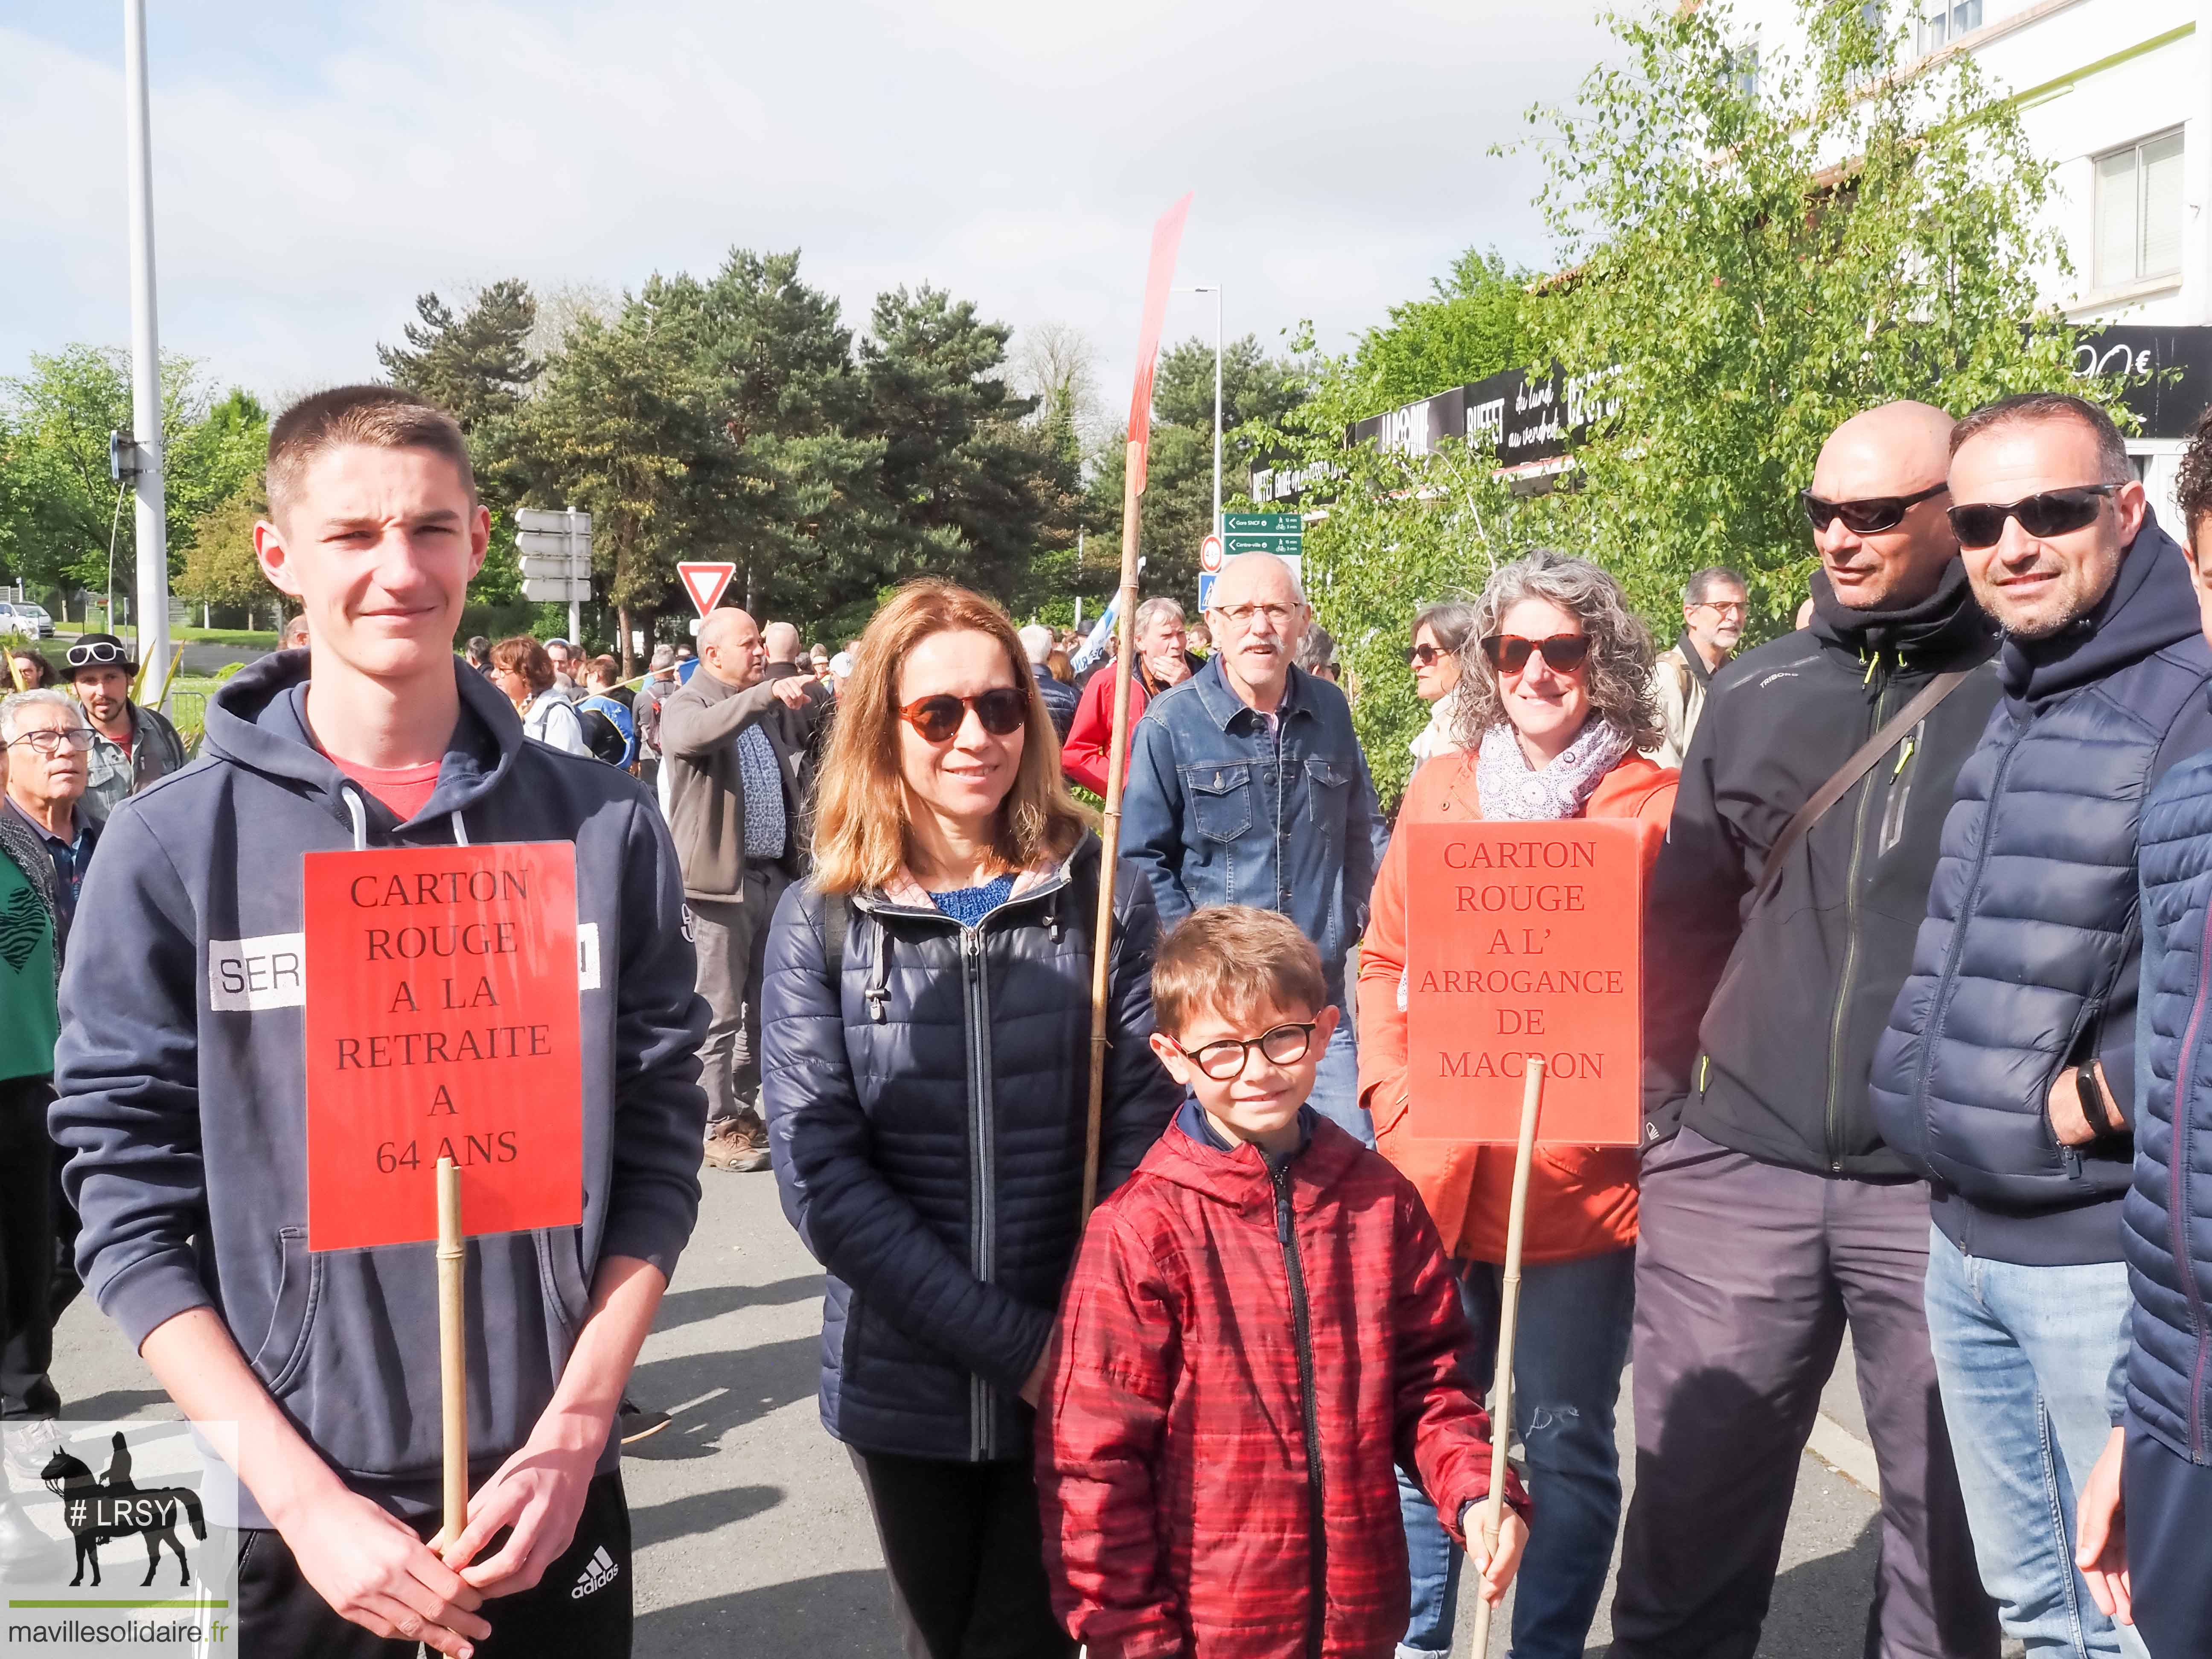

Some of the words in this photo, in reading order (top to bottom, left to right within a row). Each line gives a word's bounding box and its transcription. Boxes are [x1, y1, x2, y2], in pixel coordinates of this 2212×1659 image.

[1516, 381, 1528, 415] du
[1529, 380, 1554, 410] lundi
[1467, 398, 1505, 449] BUFFET
[1508, 432, 1522, 448] au
[1522, 407, 1561, 445] vendredi
[1444, 841, 1597, 868] CARTON
[350, 869, 529, 908] CARTON
[1455, 885, 1585, 911] ROUGE
[366, 922, 518, 961] ROUGE
[1487, 928, 1513, 955] A
[221, 952, 300, 994] SER
[1418, 970, 1624, 994] ARROGANCE
[388, 981, 420, 1013] A
[442, 976, 500, 1010] LA
[1496, 1009, 1545, 1035] DE
[335, 1025, 552, 1070] RETRAITE
[427, 1084, 460, 1117] A
[376, 1140, 421, 1174] 64
[431, 1130, 518, 1169] ANS
[571, 1563, 619, 1599] adidas
